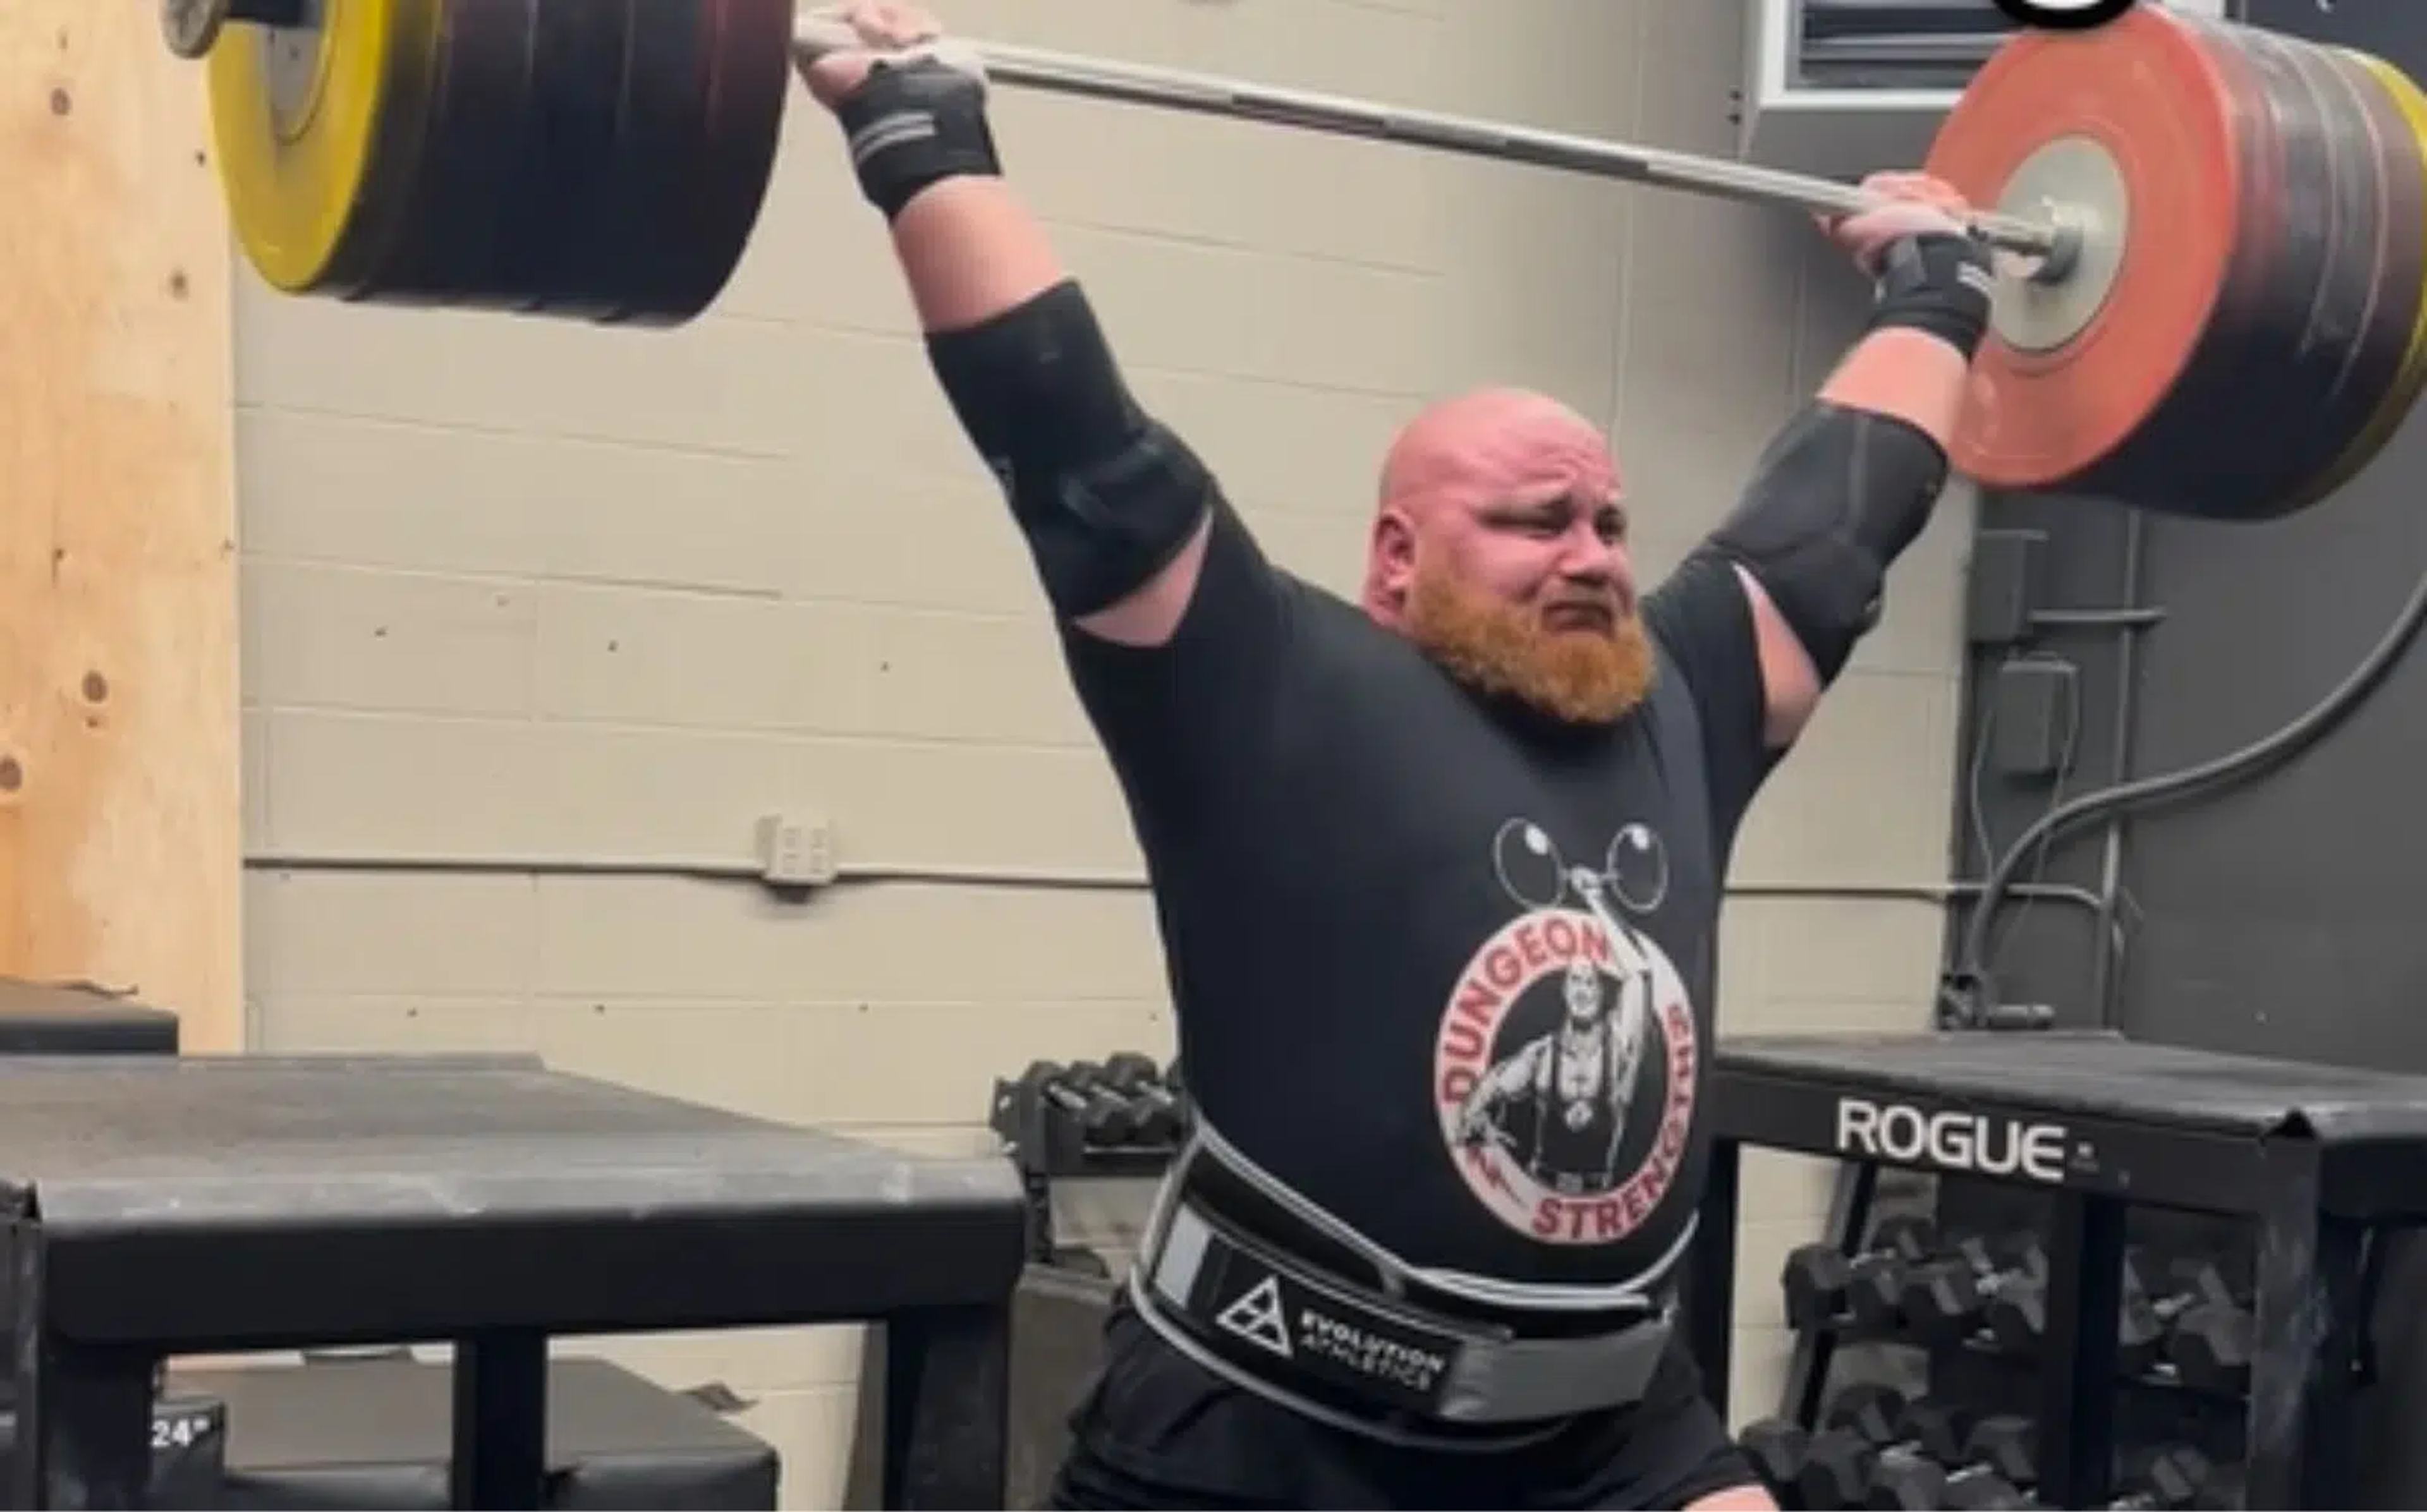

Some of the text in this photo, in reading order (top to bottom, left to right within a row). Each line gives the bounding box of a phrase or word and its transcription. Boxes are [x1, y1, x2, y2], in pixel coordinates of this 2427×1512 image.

[1442, 917, 1608, 1103] DUNGEON
[1838, 1097, 2066, 1182] ROGUE
[1301, 1310, 1444, 1372] EVOLUTION
